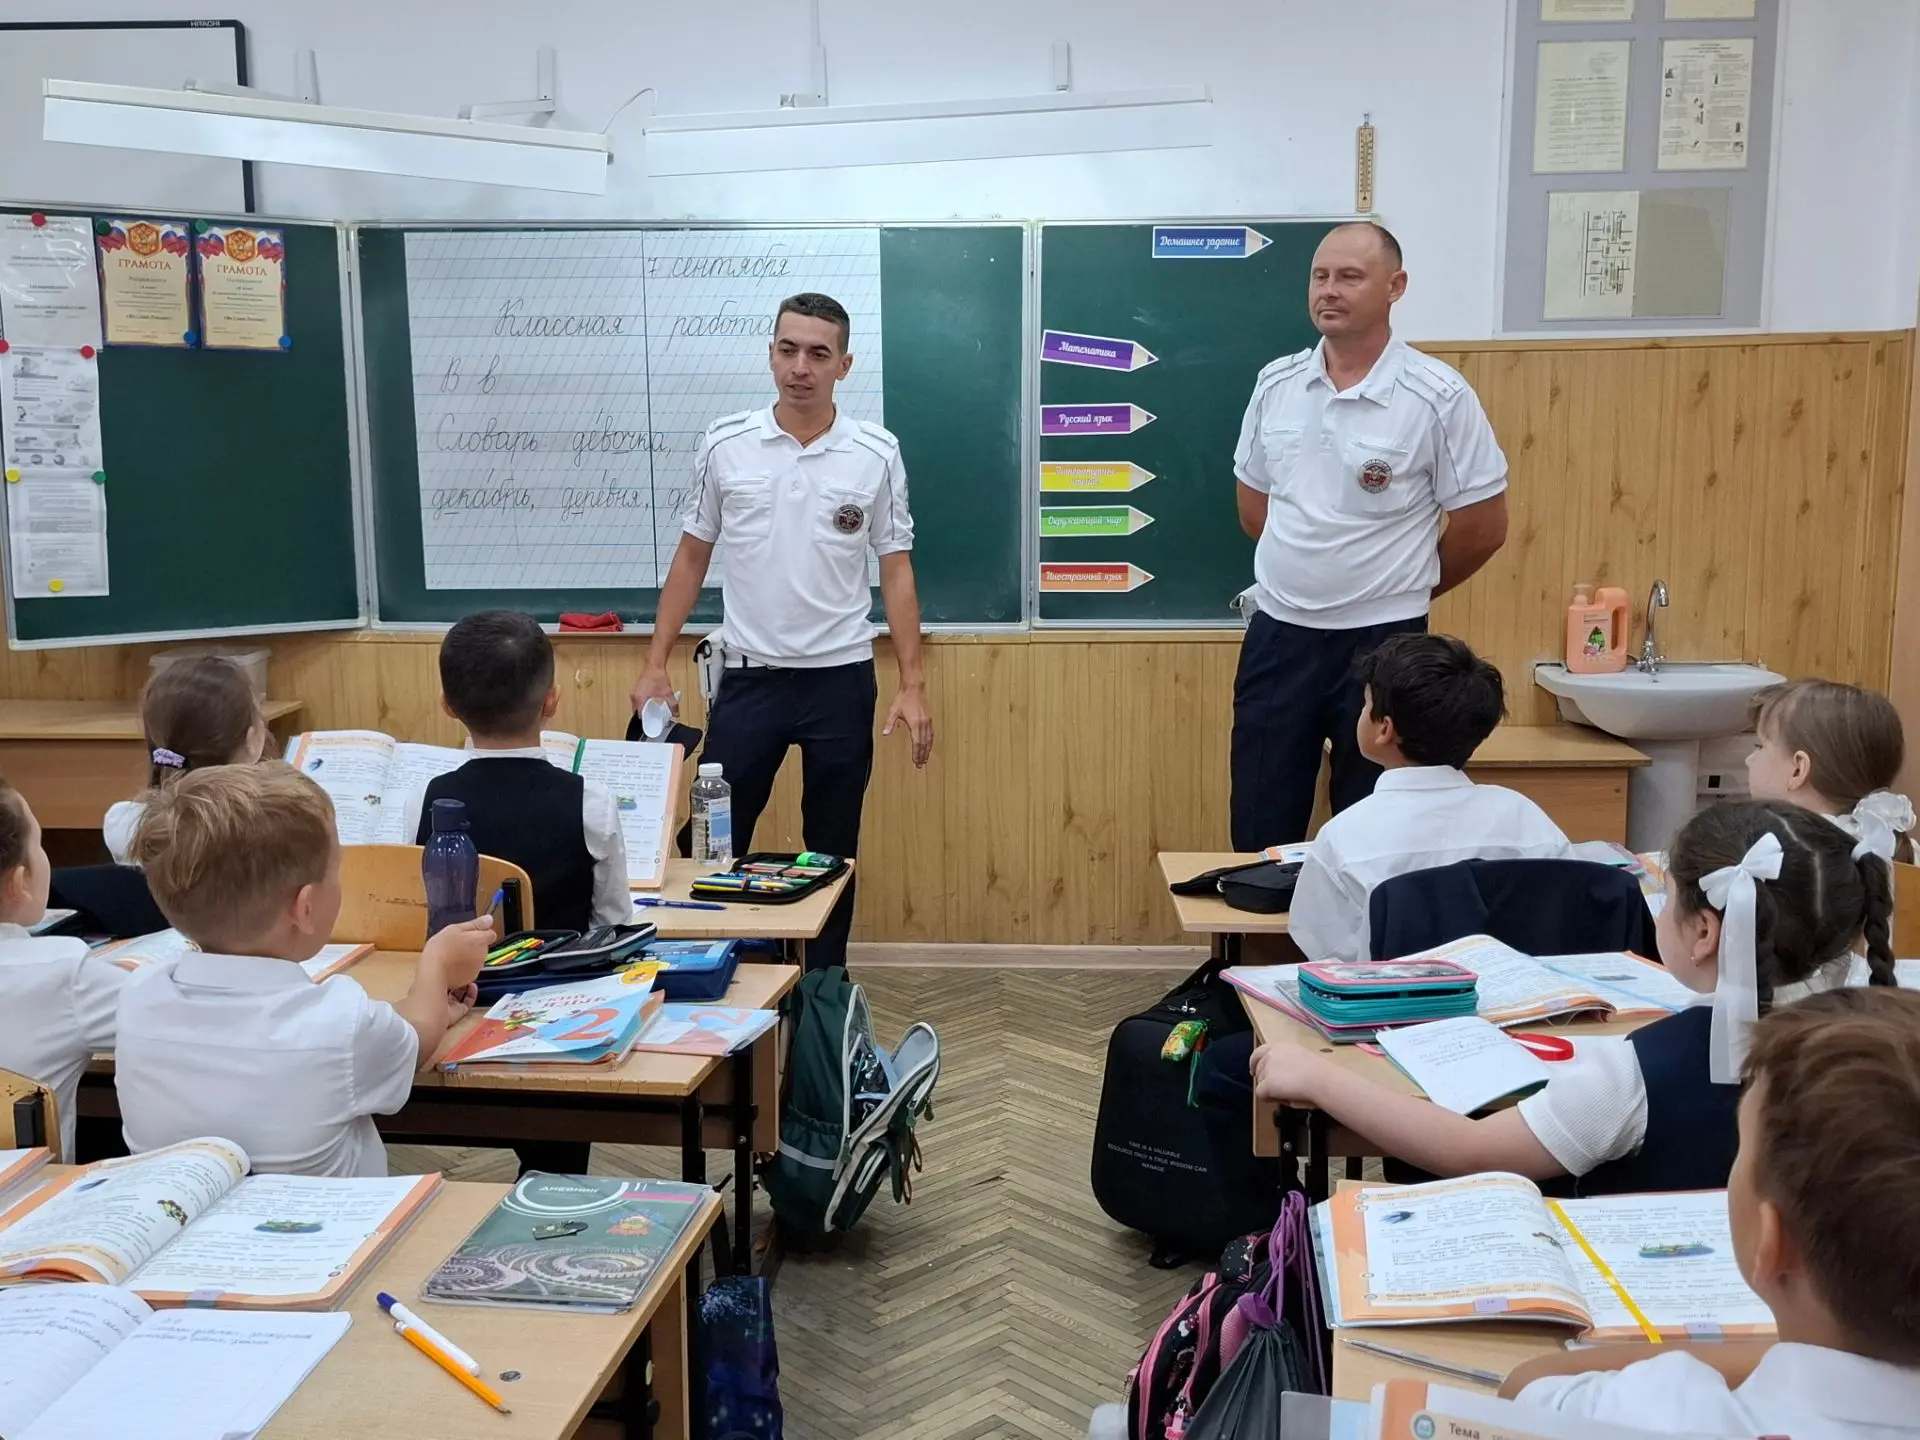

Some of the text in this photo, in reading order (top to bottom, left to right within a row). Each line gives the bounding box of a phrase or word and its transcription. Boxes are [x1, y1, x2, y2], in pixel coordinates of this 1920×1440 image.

[189, 20, 222, 28] HITACHI
[1159, 235, 1241, 250] Домашнее задание
[117, 257, 172, 271] ГРАМОТА
[215, 263, 268, 277] ГРАМОТА
[648, 243, 791, 288] 7 сентября
[495, 299, 626, 337] Классная
[1058, 340, 1117, 359] Математика
[440, 353, 500, 395] В в
[1058, 413, 1114, 427] Русский язык
[1047, 514, 1103, 529] Окружающий
[1046, 570, 1123, 585] Иностранный язык
[552, 1007, 620, 1041] 2
[1449, 1421, 1481, 1440] Тема
